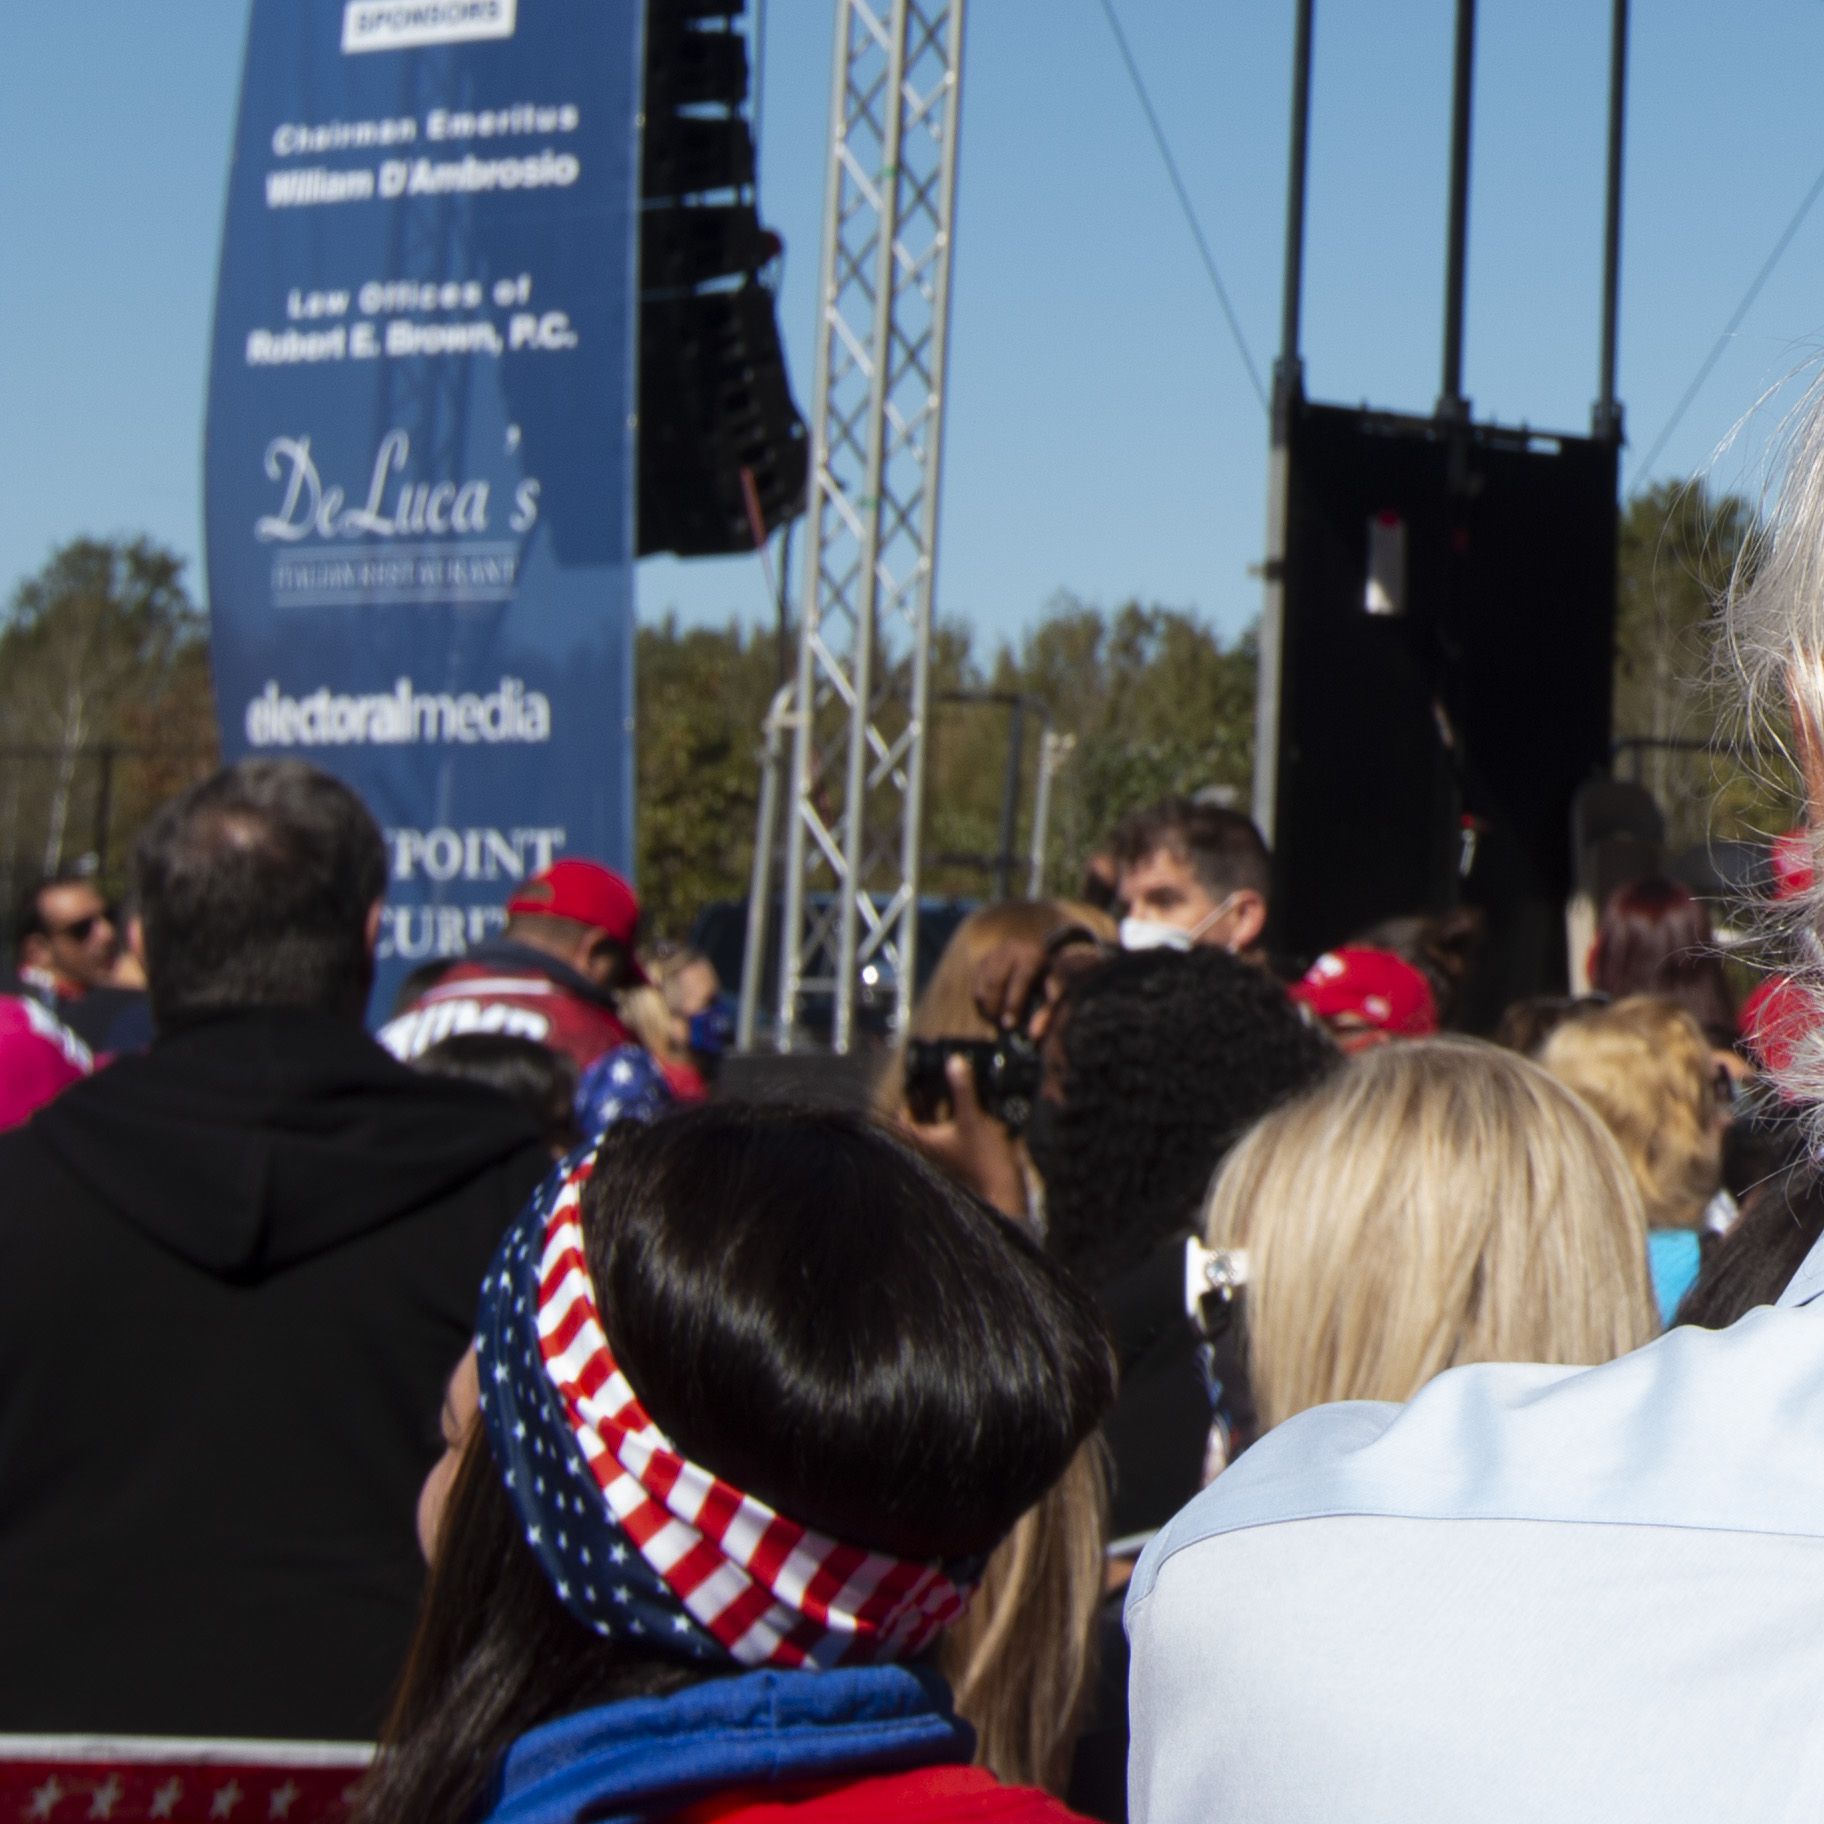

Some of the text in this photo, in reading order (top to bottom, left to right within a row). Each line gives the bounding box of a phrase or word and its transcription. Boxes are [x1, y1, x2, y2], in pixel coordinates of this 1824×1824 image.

[271, 104, 579, 157] Chairman Emeritus
[266, 152, 580, 206] William D'Ambrosio
[287, 274, 532, 320] Law Offices of
[246, 311, 578, 364] Robert E. Brown, P.C.
[245, 676, 551, 747] electoralmedia
[386, 827, 571, 882] POINT
